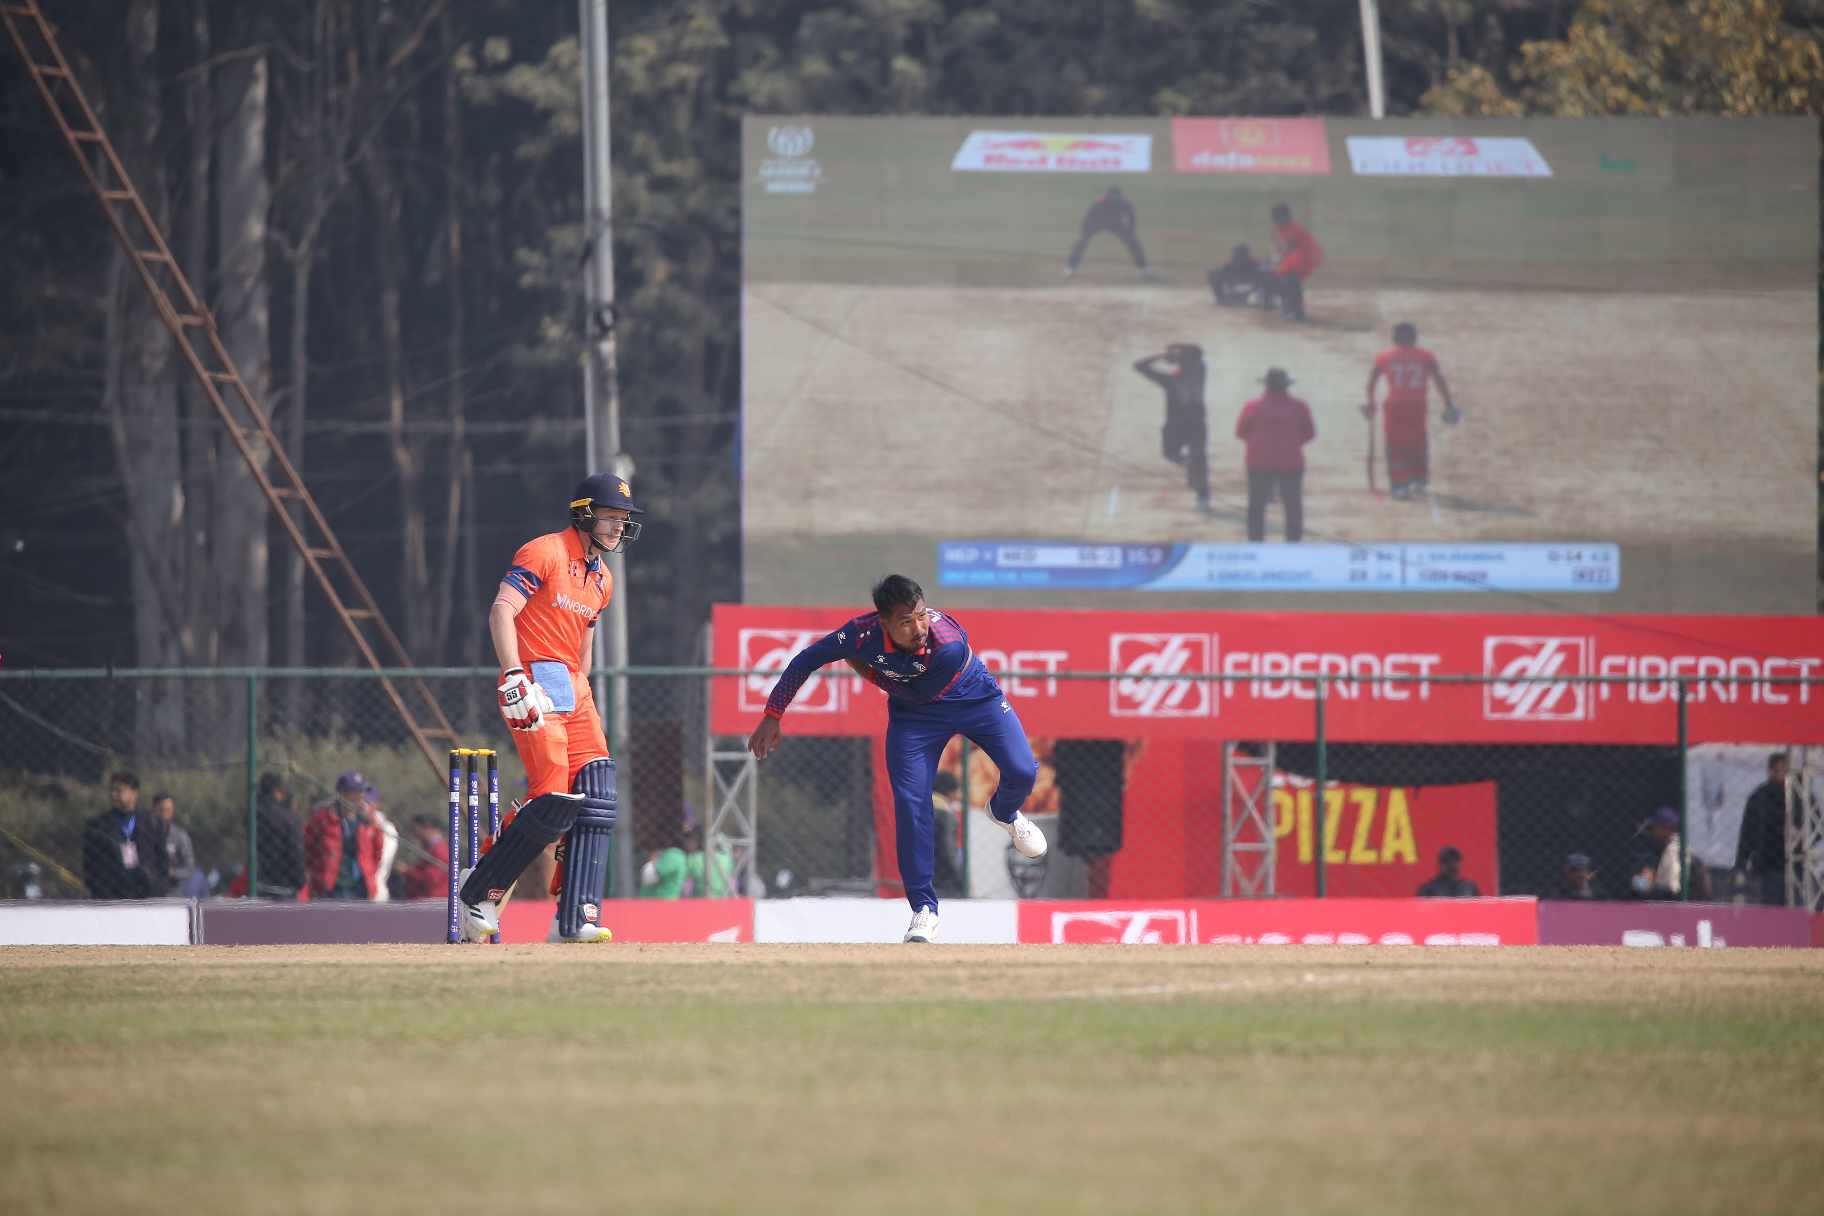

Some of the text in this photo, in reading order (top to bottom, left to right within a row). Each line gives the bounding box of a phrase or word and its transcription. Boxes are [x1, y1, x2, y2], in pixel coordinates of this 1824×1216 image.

[1223, 652, 1440, 700] FIBERNET
[1600, 655, 1822, 704] FIBERNET
[1270, 787, 1418, 864] PIZZA
